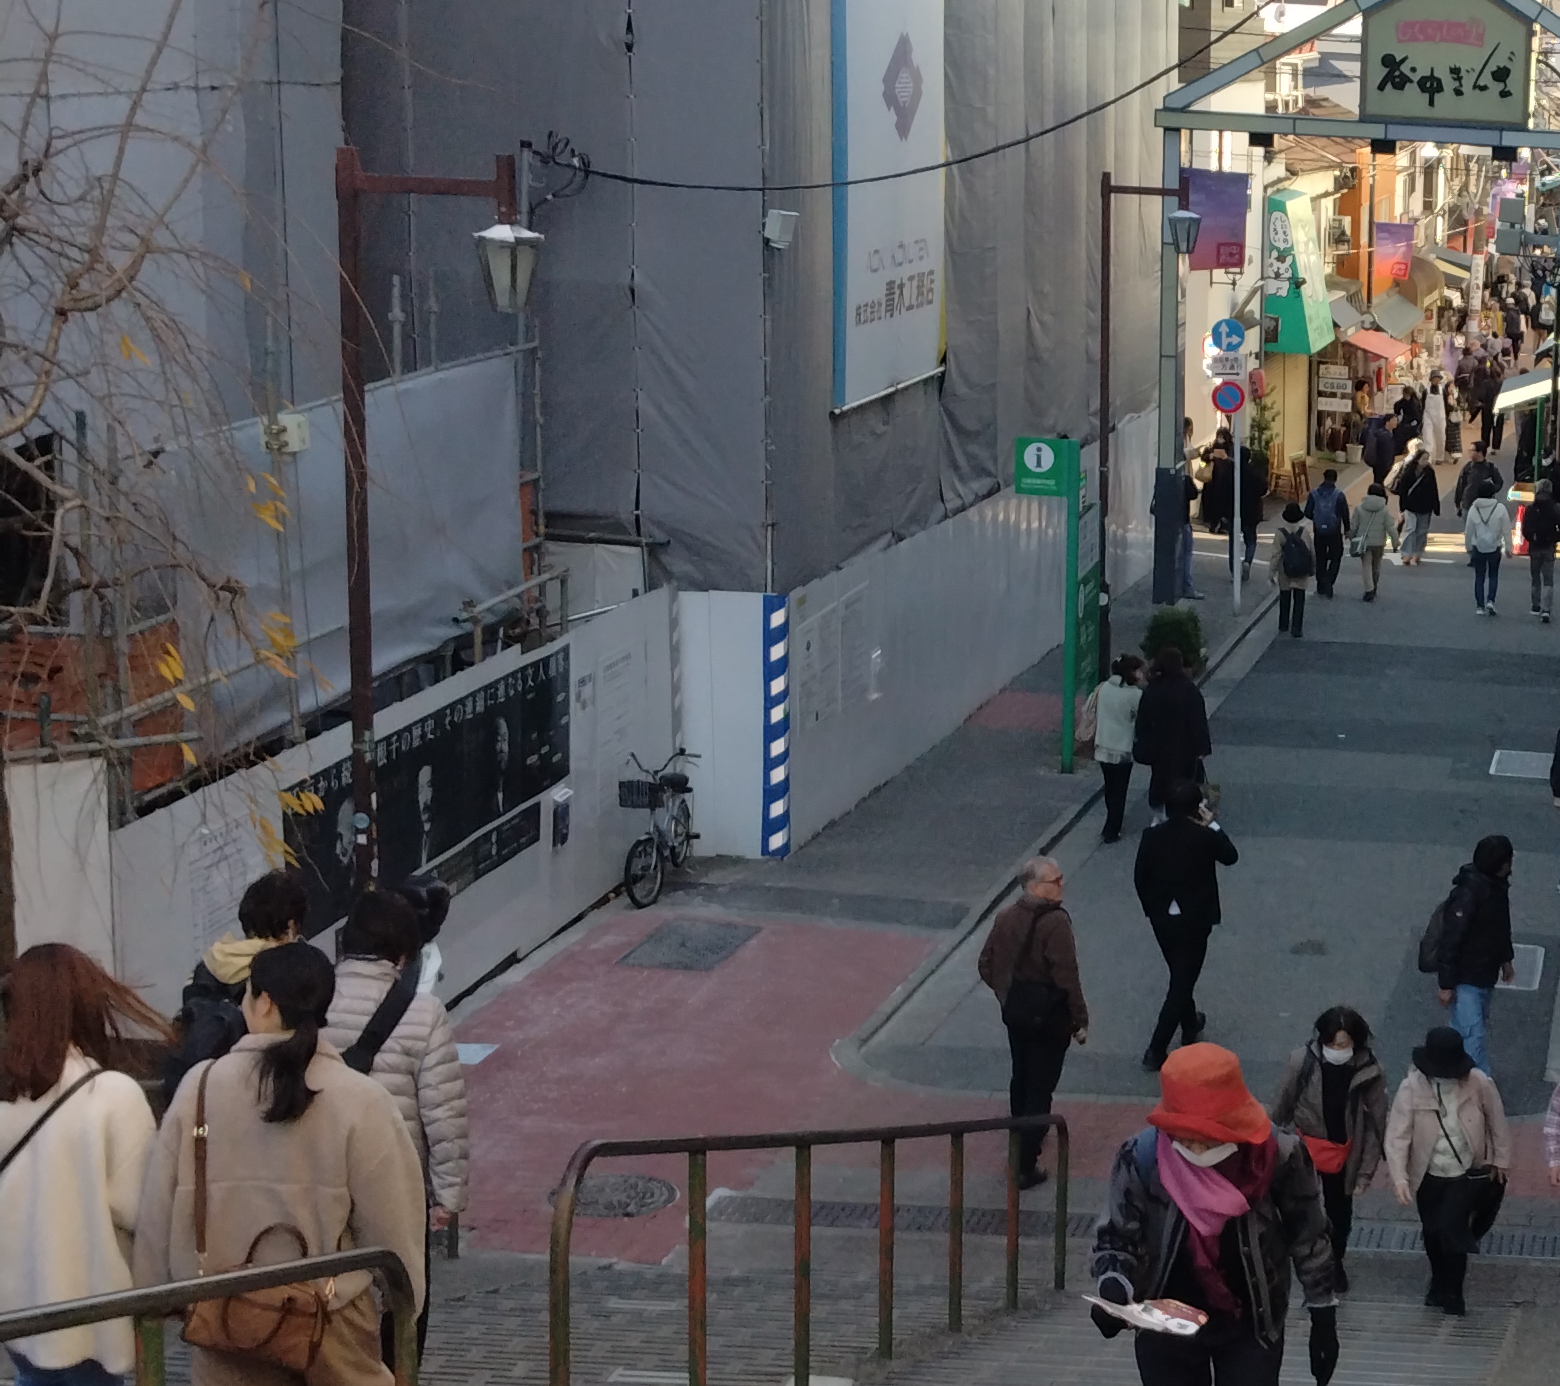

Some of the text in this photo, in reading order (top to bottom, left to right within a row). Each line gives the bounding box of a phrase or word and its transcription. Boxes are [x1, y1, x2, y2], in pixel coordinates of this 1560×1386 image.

[1377, 42, 1516, 108] 谷中ぎんざ
